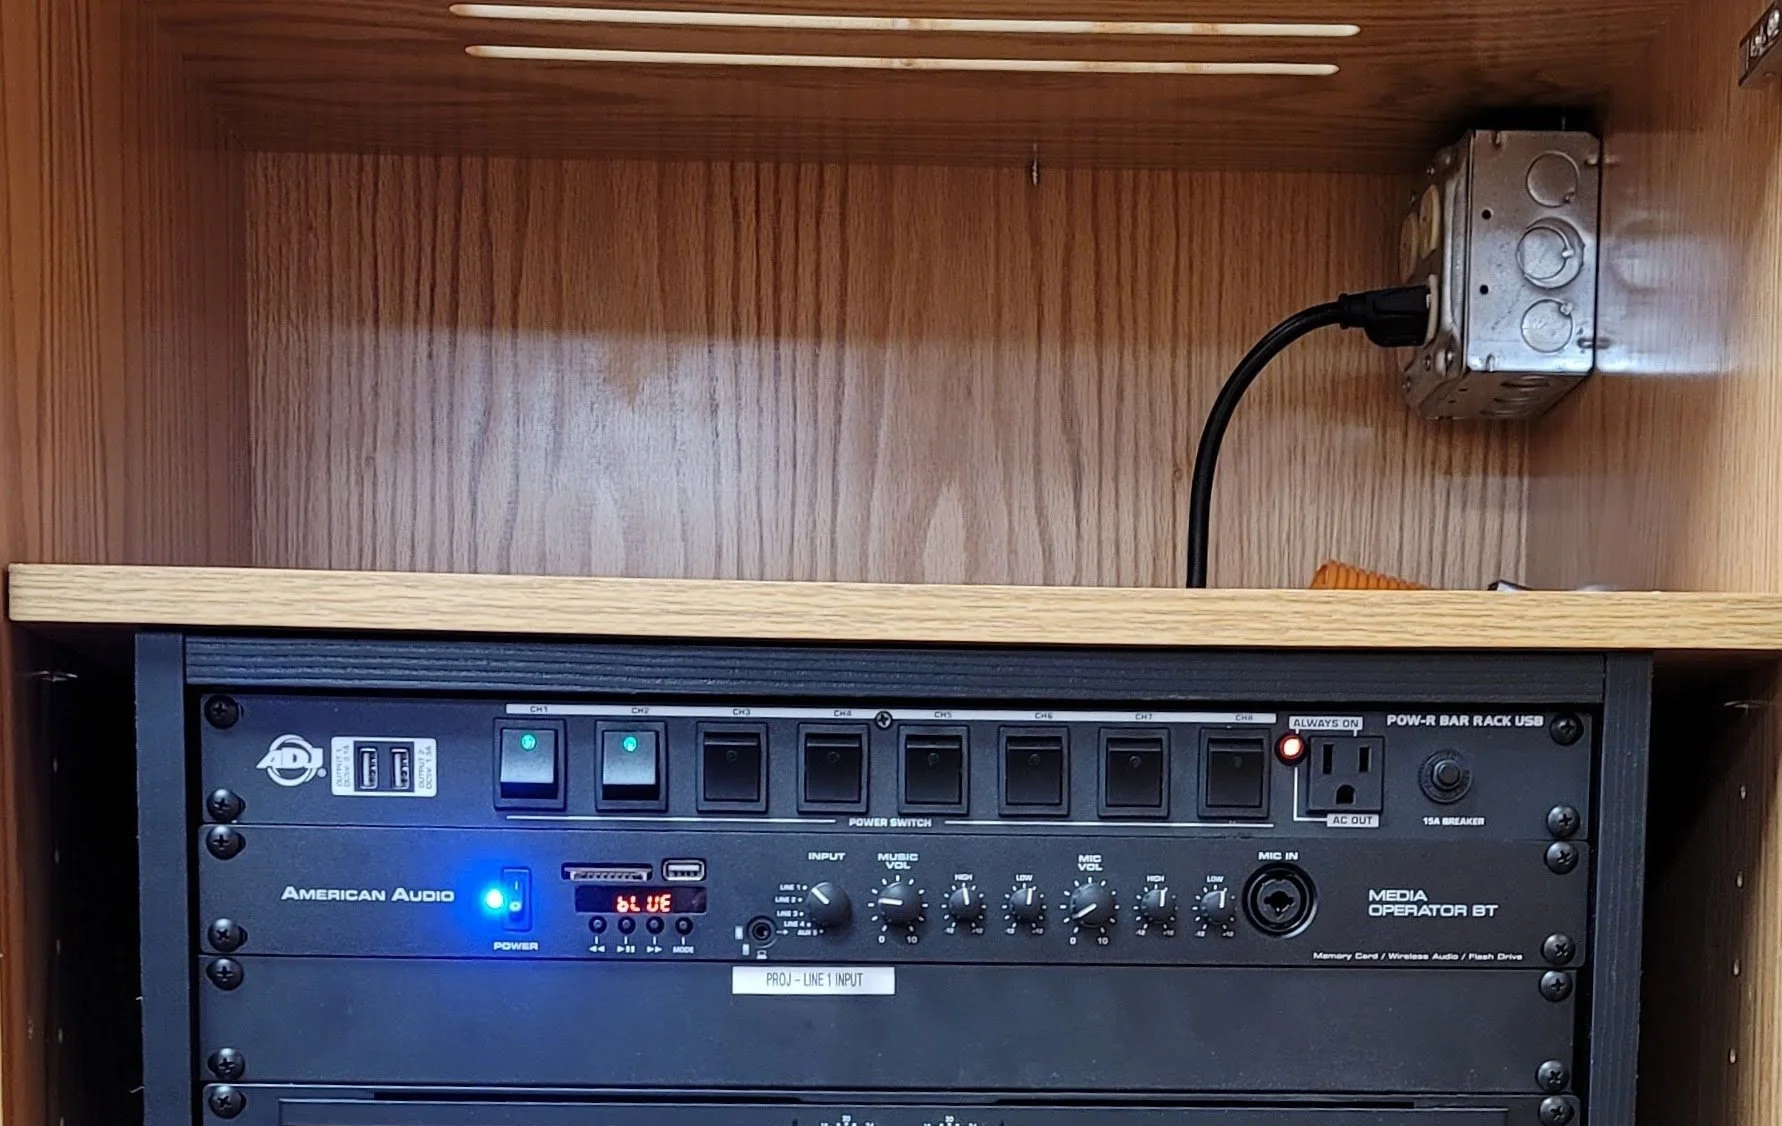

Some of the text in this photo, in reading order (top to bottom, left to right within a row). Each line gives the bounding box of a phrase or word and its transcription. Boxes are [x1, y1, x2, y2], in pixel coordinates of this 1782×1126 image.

[1293, 718, 1359, 729] ALWAYS ON
[1387, 714, 1544, 727] POW-R BAR RACK USB
[335, 756, 343, 787] OUTPUT
[849, 817, 932, 827] POWER SWITCH
[1332, 816, 1373, 825] AC OUT
[1423, 817, 1485, 826] 15A BREAKER
[808, 852, 846, 861] INPUT
[878, 853, 919, 862] MUSIC
[1078, 855, 1102, 863] MIC
[1258, 851, 1298, 860] MIC IN
[885, 861, 911, 870] VOL
[1077, 863, 1103, 871] VOL
[281, 885, 455, 902] AMERICAN AUDIO
[1369, 889, 1427, 902] MEDIA
[1368, 904, 1499, 917] OPERATOR BT
[878, 936, 885, 944] 0
[907, 936, 918, 944] 10
[1069, 937, 1077, 945] 0
[1098, 937, 1109, 945] 10
[493, 941, 538, 951] POWER
[673, 946, 694, 954] MODE
[1313, 952, 1352, 961] Memory
[1355, 952, 1379, 960] Card
[1388, 952, 1429, 961] Wireless
[1431, 953, 1459, 961] Audio
[1469, 953, 1494, 961] Flash
[1497, 953, 1523, 961] Drive
[767, 973, 791, 987] PROJ
[804, 973, 824, 987] LINE
[835, 973, 864, 987] INPUT
